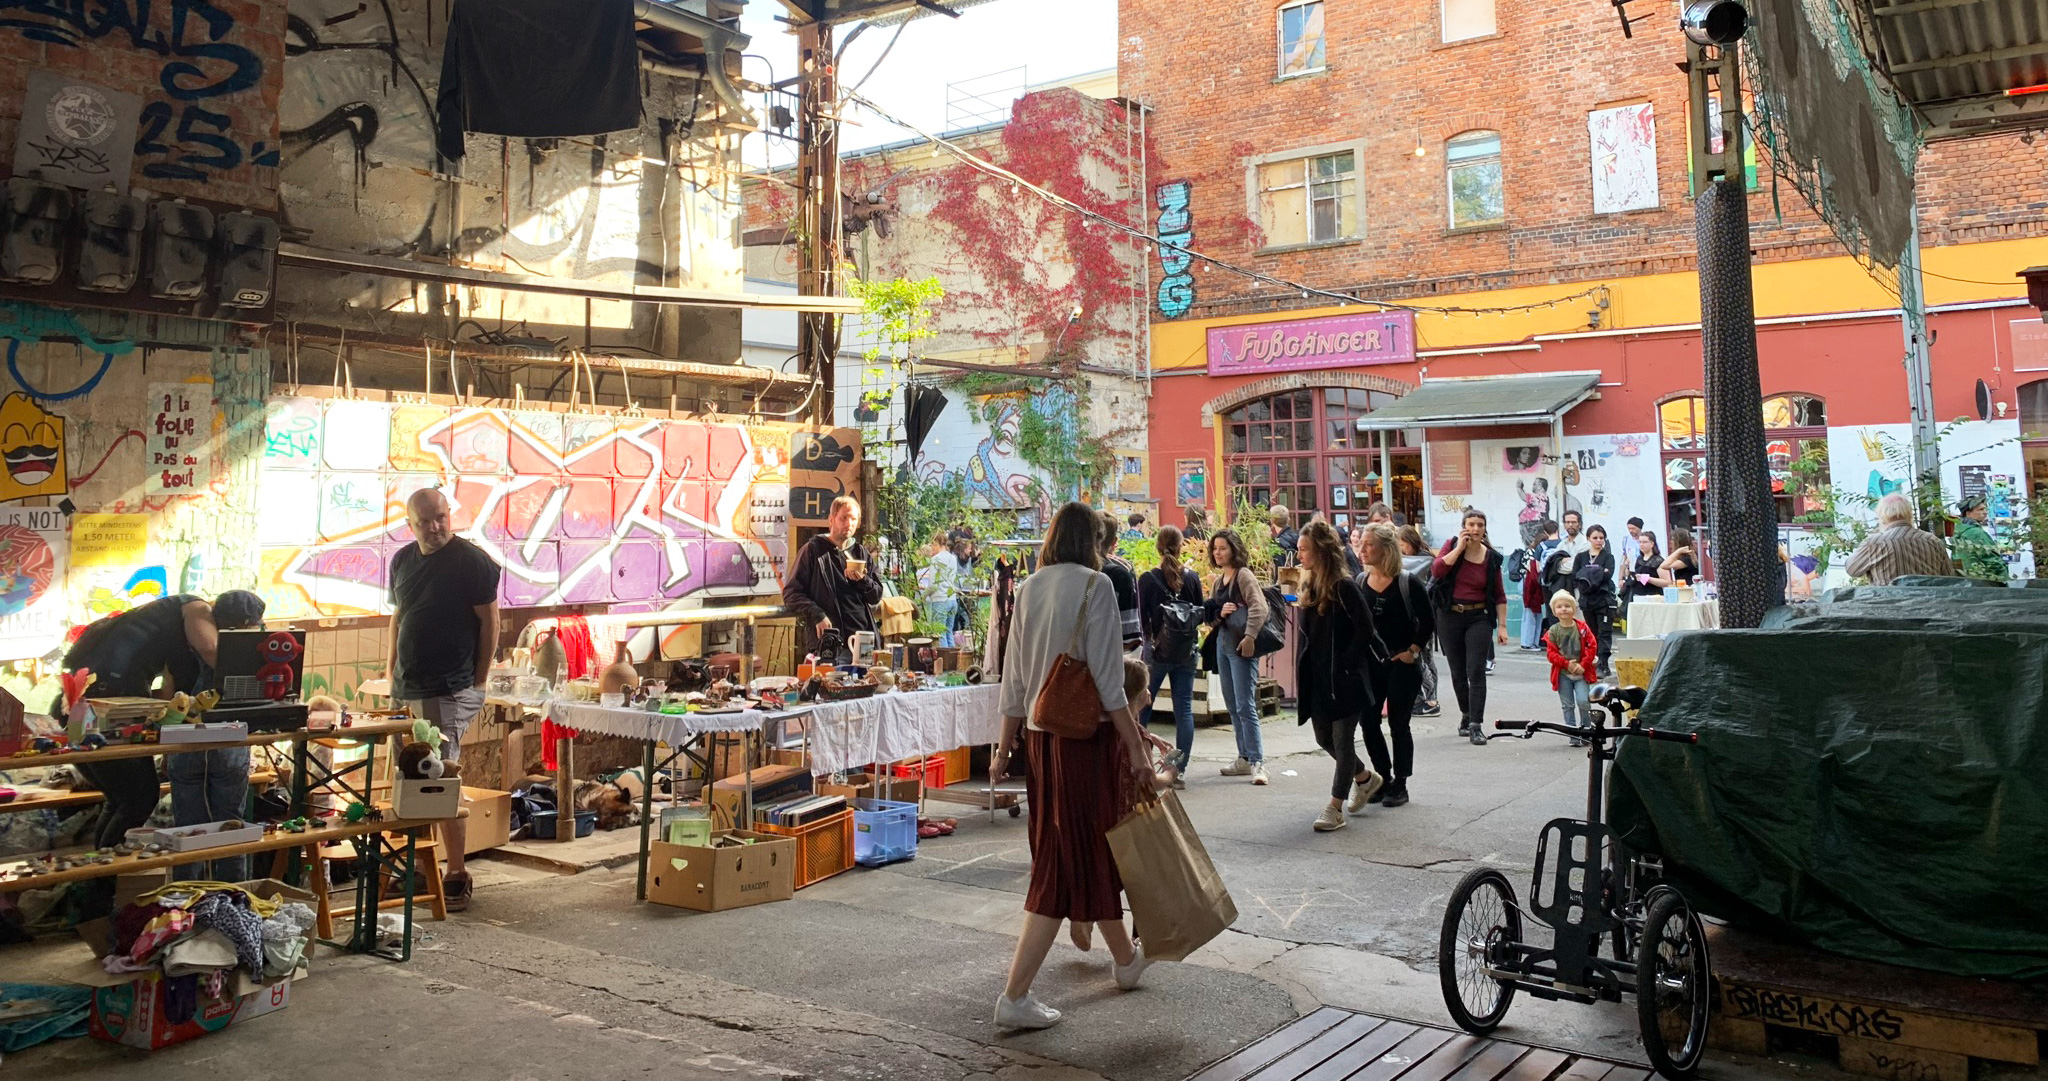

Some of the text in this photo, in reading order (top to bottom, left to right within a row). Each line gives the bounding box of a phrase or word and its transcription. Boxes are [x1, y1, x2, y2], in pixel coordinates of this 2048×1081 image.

[806, 437, 823, 460] D
[28, 511, 61, 529] NOT
[83, 533, 136, 542] 1,50 METER
[205, 1001, 234, 1019] pants
